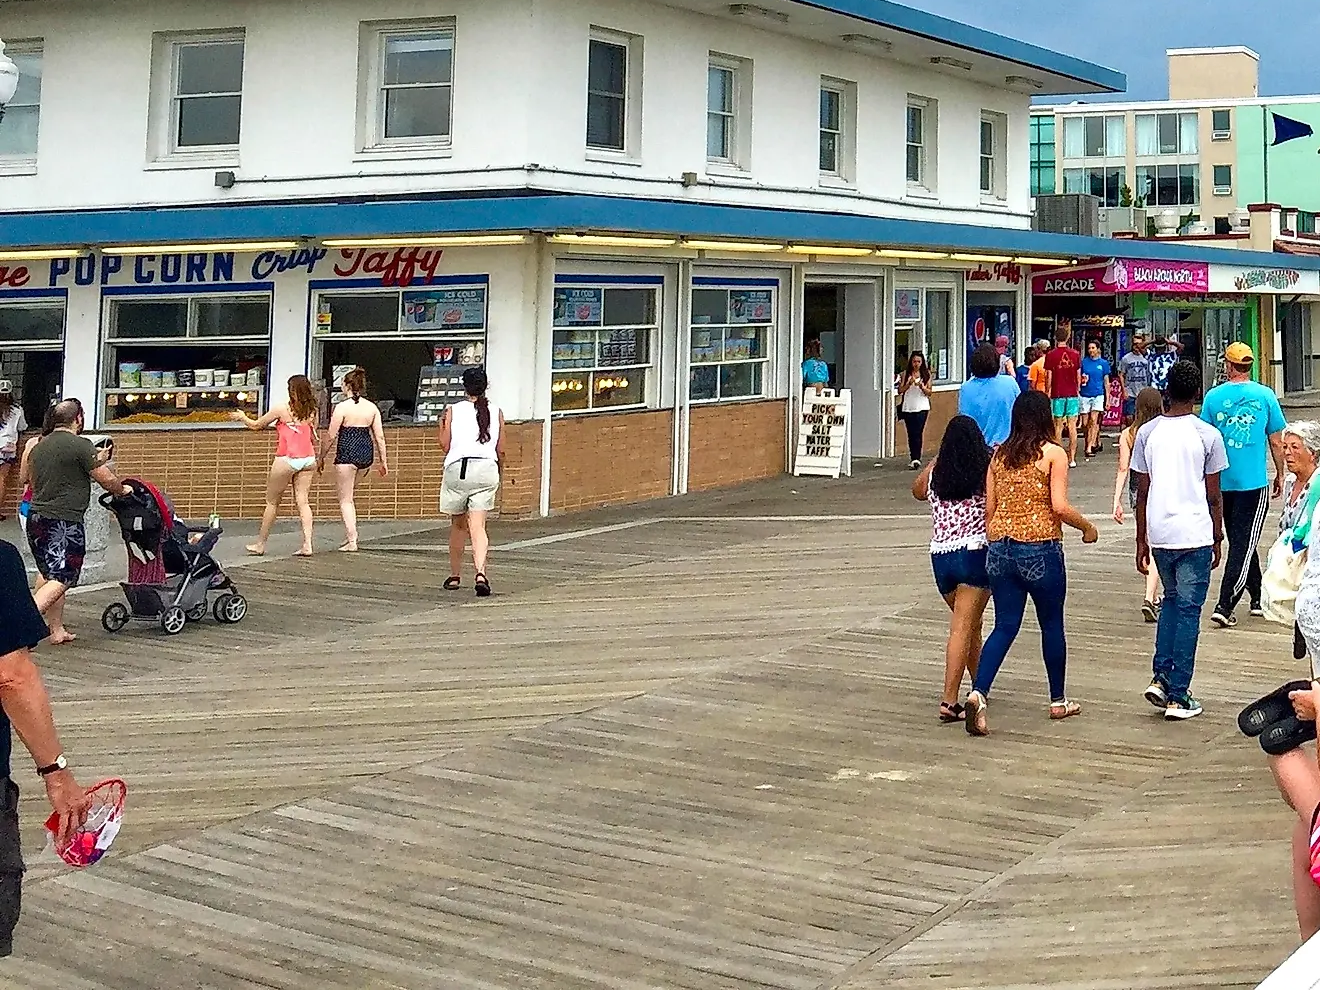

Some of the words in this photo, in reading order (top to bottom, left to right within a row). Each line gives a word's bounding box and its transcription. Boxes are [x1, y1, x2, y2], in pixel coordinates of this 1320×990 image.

[49, 252, 122, 287] POP
[134, 251, 235, 284] CORN
[333, 246, 443, 287] Taffy
[1044, 277, 1096, 291] ARCADE
[457, 290, 477, 298] COLD
[811, 403, 832, 414] PICK
[802, 414, 824, 424] YOUR
[826, 415, 845, 425] OWN
[811, 425, 832, 435] SALT
[806, 435, 831, 446] WATER
[805, 446, 831, 457] TAFFY
